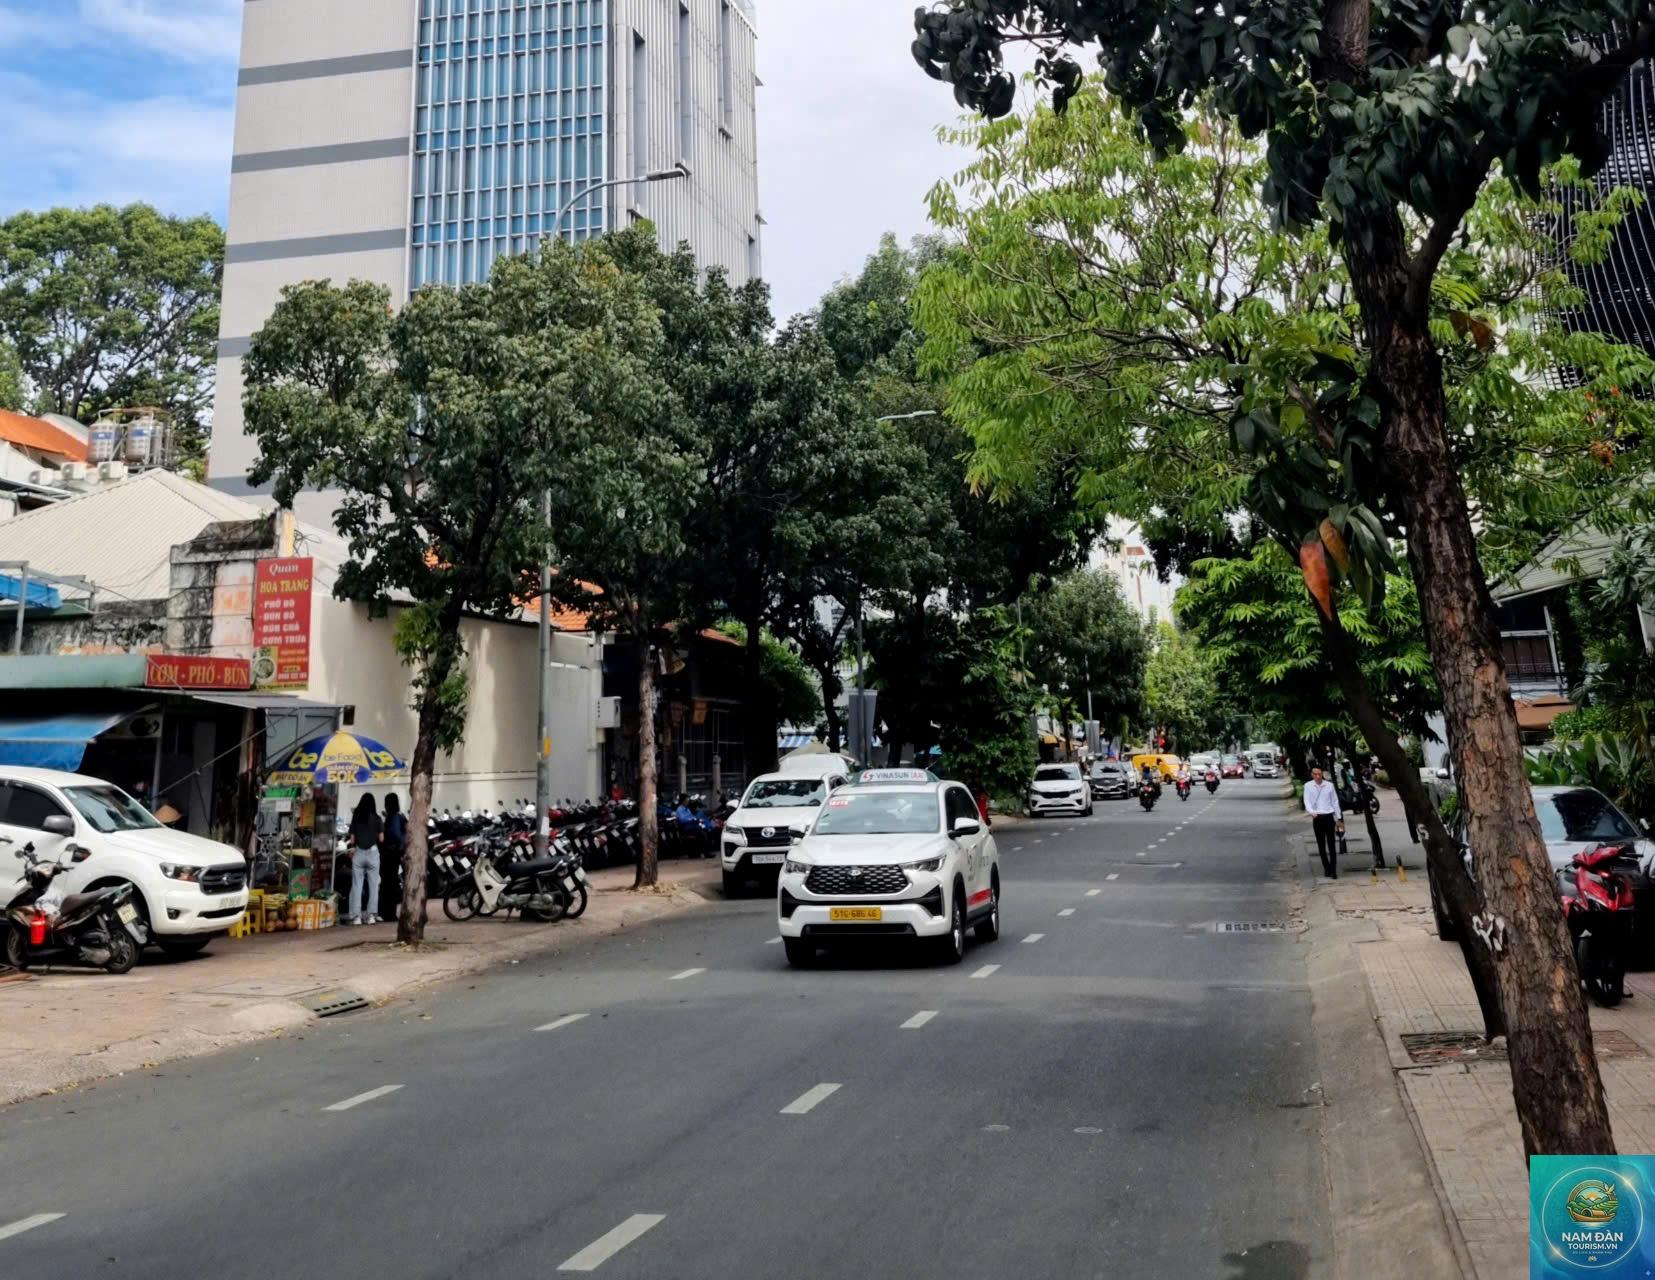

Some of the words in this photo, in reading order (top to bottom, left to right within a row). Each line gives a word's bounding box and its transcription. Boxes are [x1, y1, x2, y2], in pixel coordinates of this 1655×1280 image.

[260, 581, 278, 593] HOA
[280, 578, 309, 593] TRANG
[150, 663, 179, 683] CƠM
[188, 661, 216, 684] PHỞ
[223, 663, 249, 686] BÚN
[288, 746, 318, 769] be
[363, 746, 396, 769] be
[327, 770, 358, 783] 50K
[876, 771, 909, 779] VINASUN
